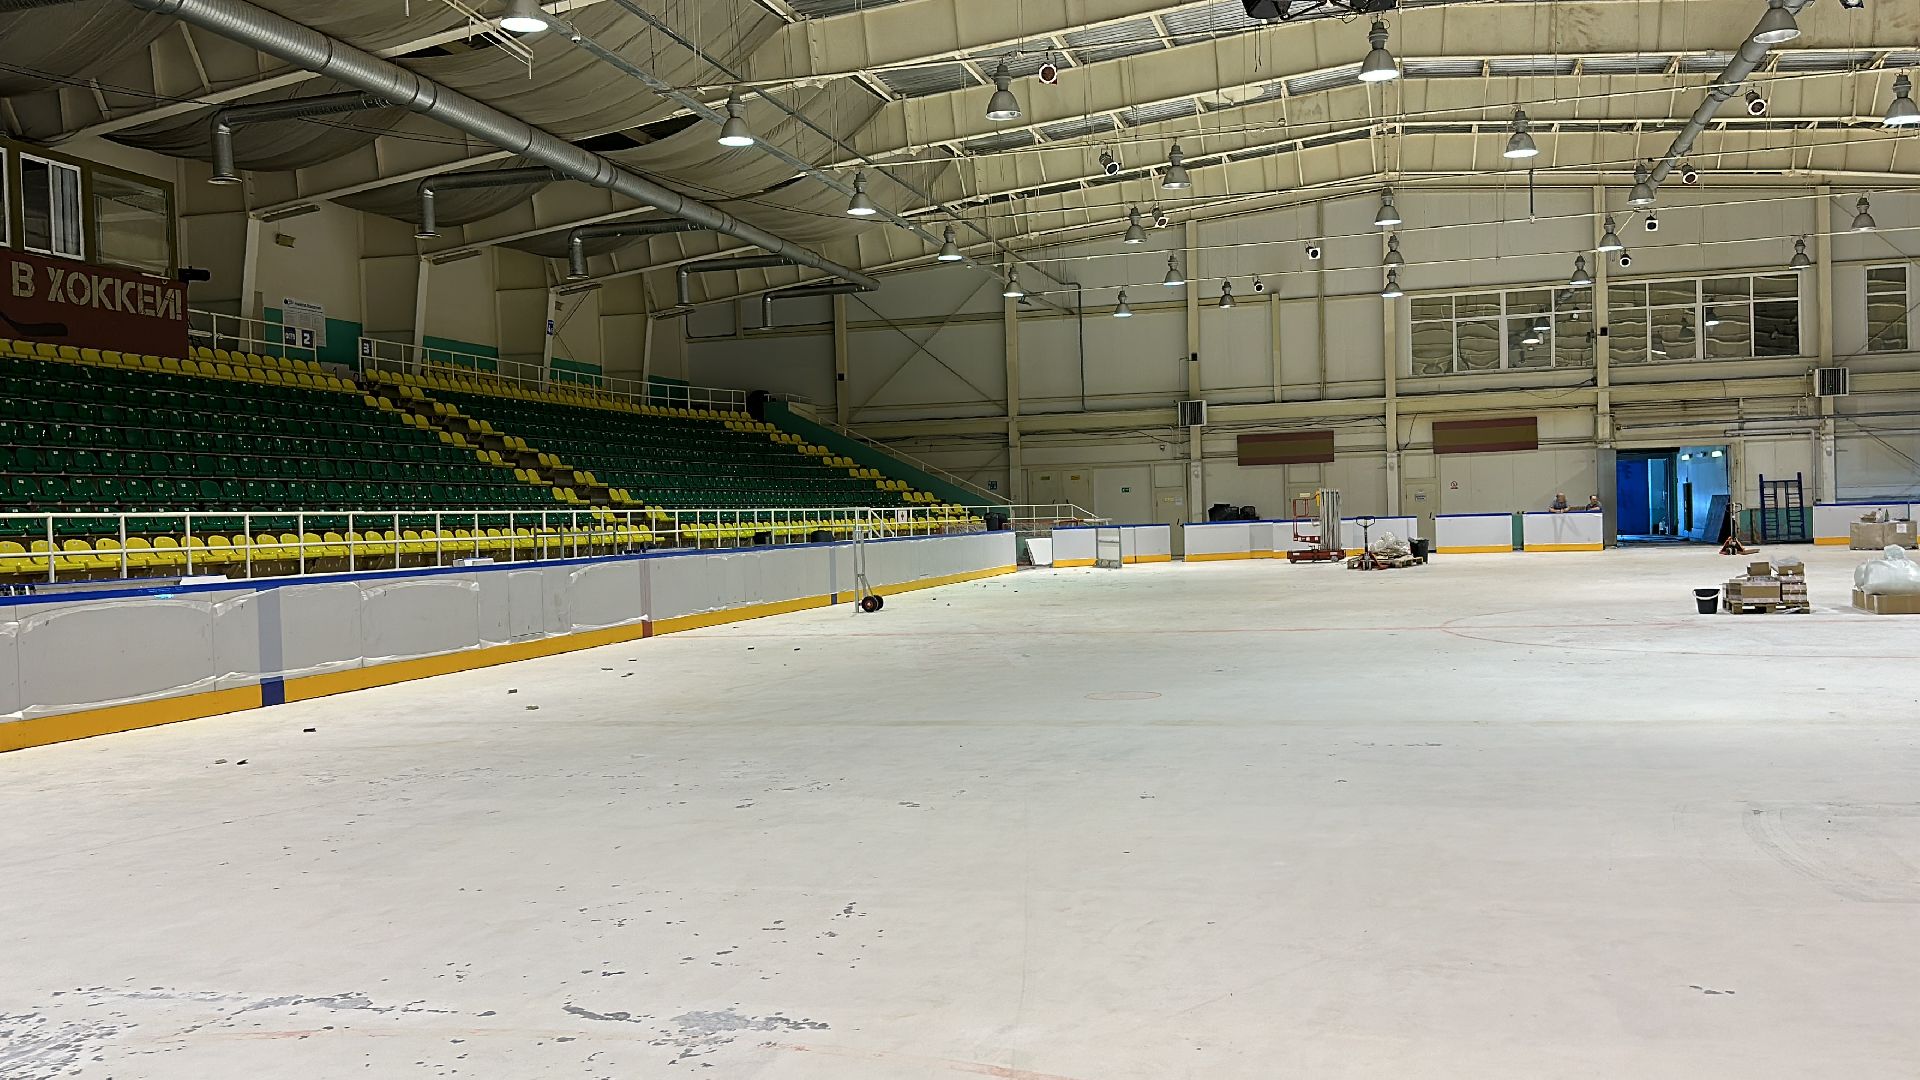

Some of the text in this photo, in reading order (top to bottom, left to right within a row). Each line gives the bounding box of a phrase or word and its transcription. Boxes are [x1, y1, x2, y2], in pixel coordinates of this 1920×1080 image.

[10, 260, 183, 321] В ХОККЕЙ!
[303, 332, 311, 344] 2
[363, 342, 370, 354] 3
